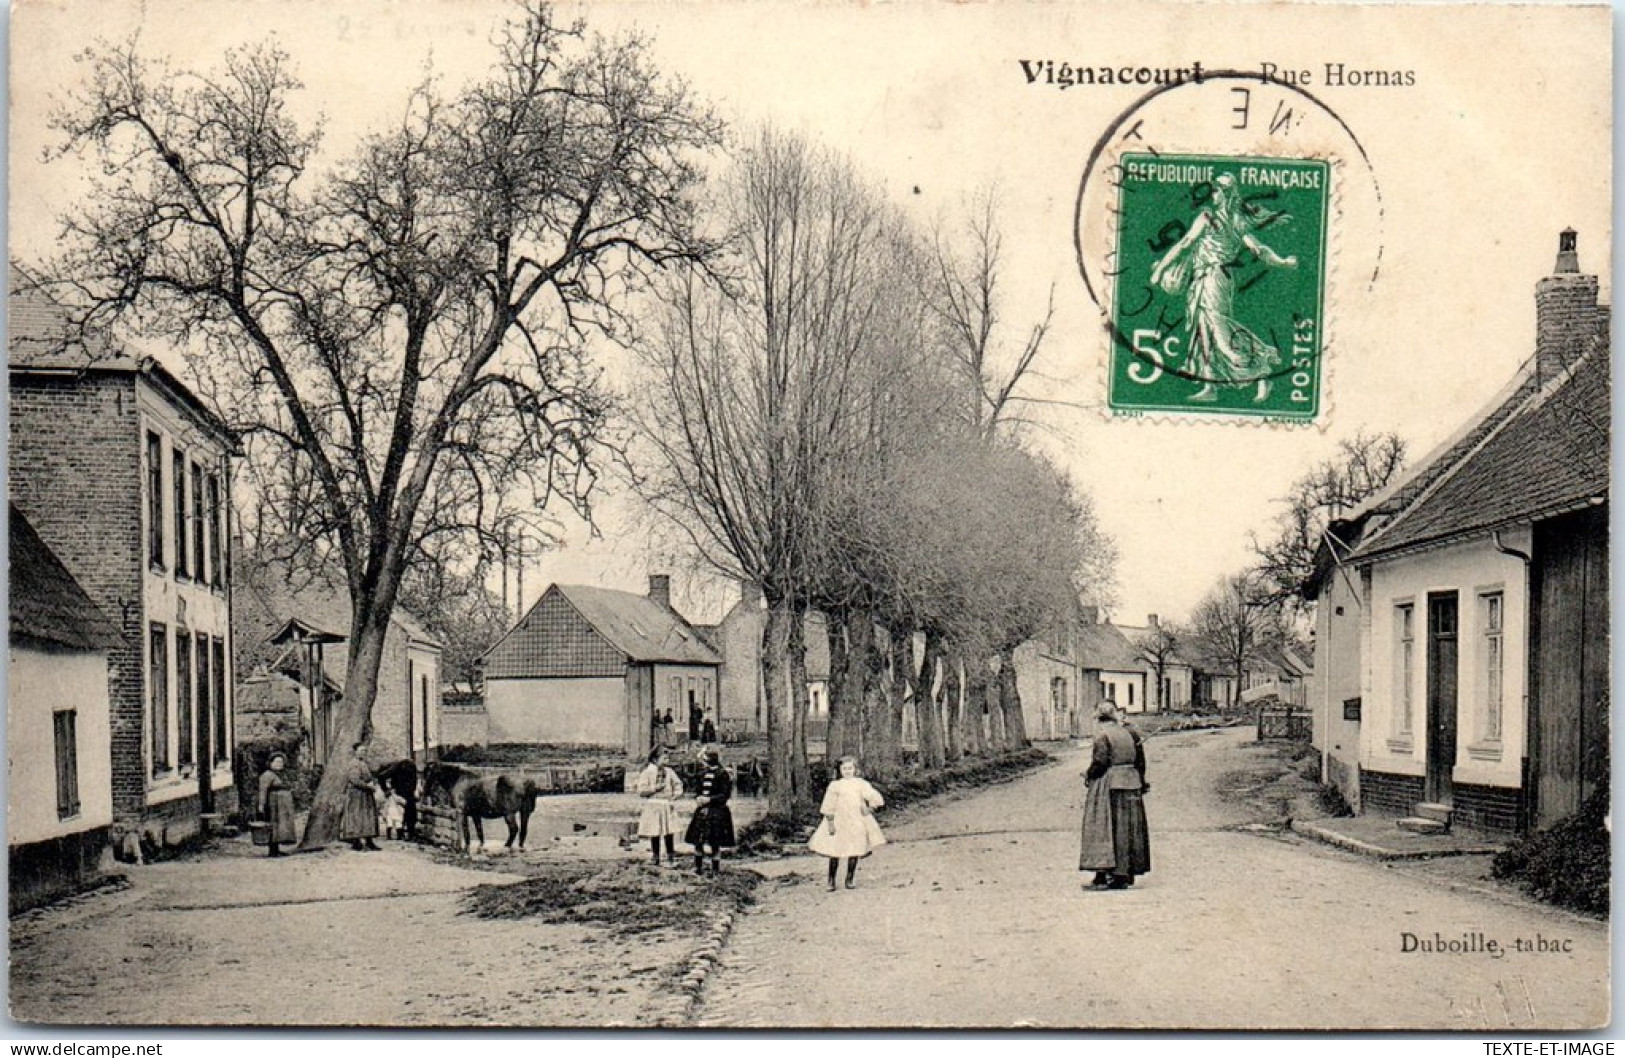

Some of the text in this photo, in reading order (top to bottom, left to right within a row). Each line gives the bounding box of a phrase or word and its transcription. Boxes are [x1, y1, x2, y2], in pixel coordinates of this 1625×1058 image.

[1018, 60, 1415, 90] Vignacourt Rue Hornas
[1240, 167, 1320, 189] FRANÇAISE
[1290, 317, 1315, 403] POSTES
[1400, 932, 1573, 959] Duboille, tabac
